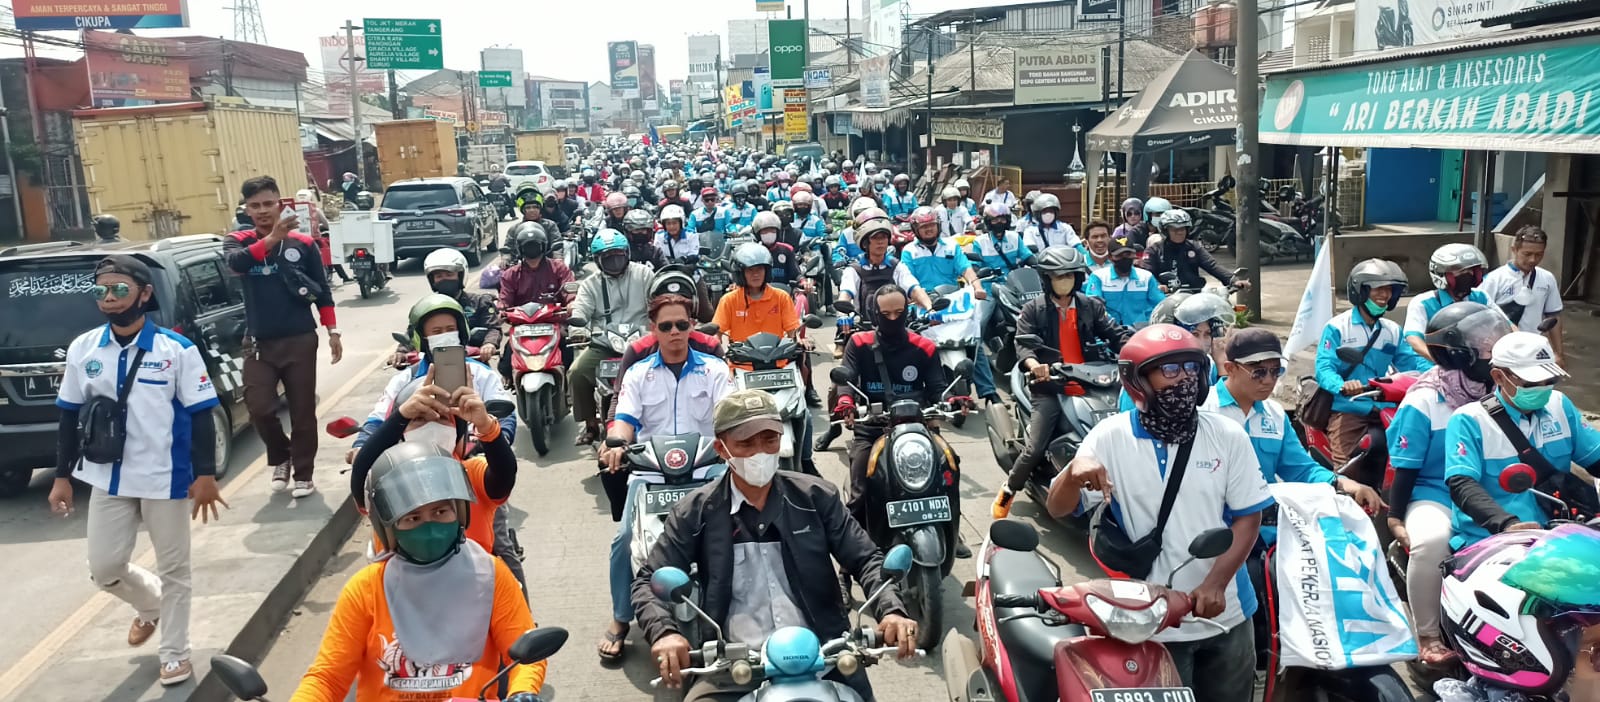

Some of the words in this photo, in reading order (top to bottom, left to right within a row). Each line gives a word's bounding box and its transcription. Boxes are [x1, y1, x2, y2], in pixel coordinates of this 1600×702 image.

[30, 6, 52, 14] AMAN
[55, 5, 103, 13] TERPERCAYA
[105, 5, 110, 13] &
[112, 4, 141, 12] SANGAT
[143, 3, 168, 11] TINGGI
[1447, 6, 1473, 17] SINAR
[1476, 1, 1494, 13] INTI
[75, 16, 111, 28] CIKUPA
[774, 44, 803, 54] oppo
[1019, 56, 1051, 66] PUTRA
[1056, 55, 1088, 65] ABADI
[1090, 54, 1096, 64] 3
[1367, 71, 1396, 95] TOKO
[1400, 66, 1432, 92] ALAT
[1437, 64, 1446, 89] &
[1452, 53, 1546, 88] AKSESORIS
[1169, 89, 1238, 107] ADIR
[1342, 101, 1379, 131] ARI
[1383, 96, 1480, 130] BERKAH
[1487, 90, 1592, 130] ABADI
[29, 377, 36, 390] A
[646, 494, 653, 504] B
[889, 504, 895, 514] B
[901, 501, 924, 512] 4101
[929, 499, 948, 509] NDX
[1301, 556, 1320, 616] PEKERJA
[1095, 692, 1105, 702] B
